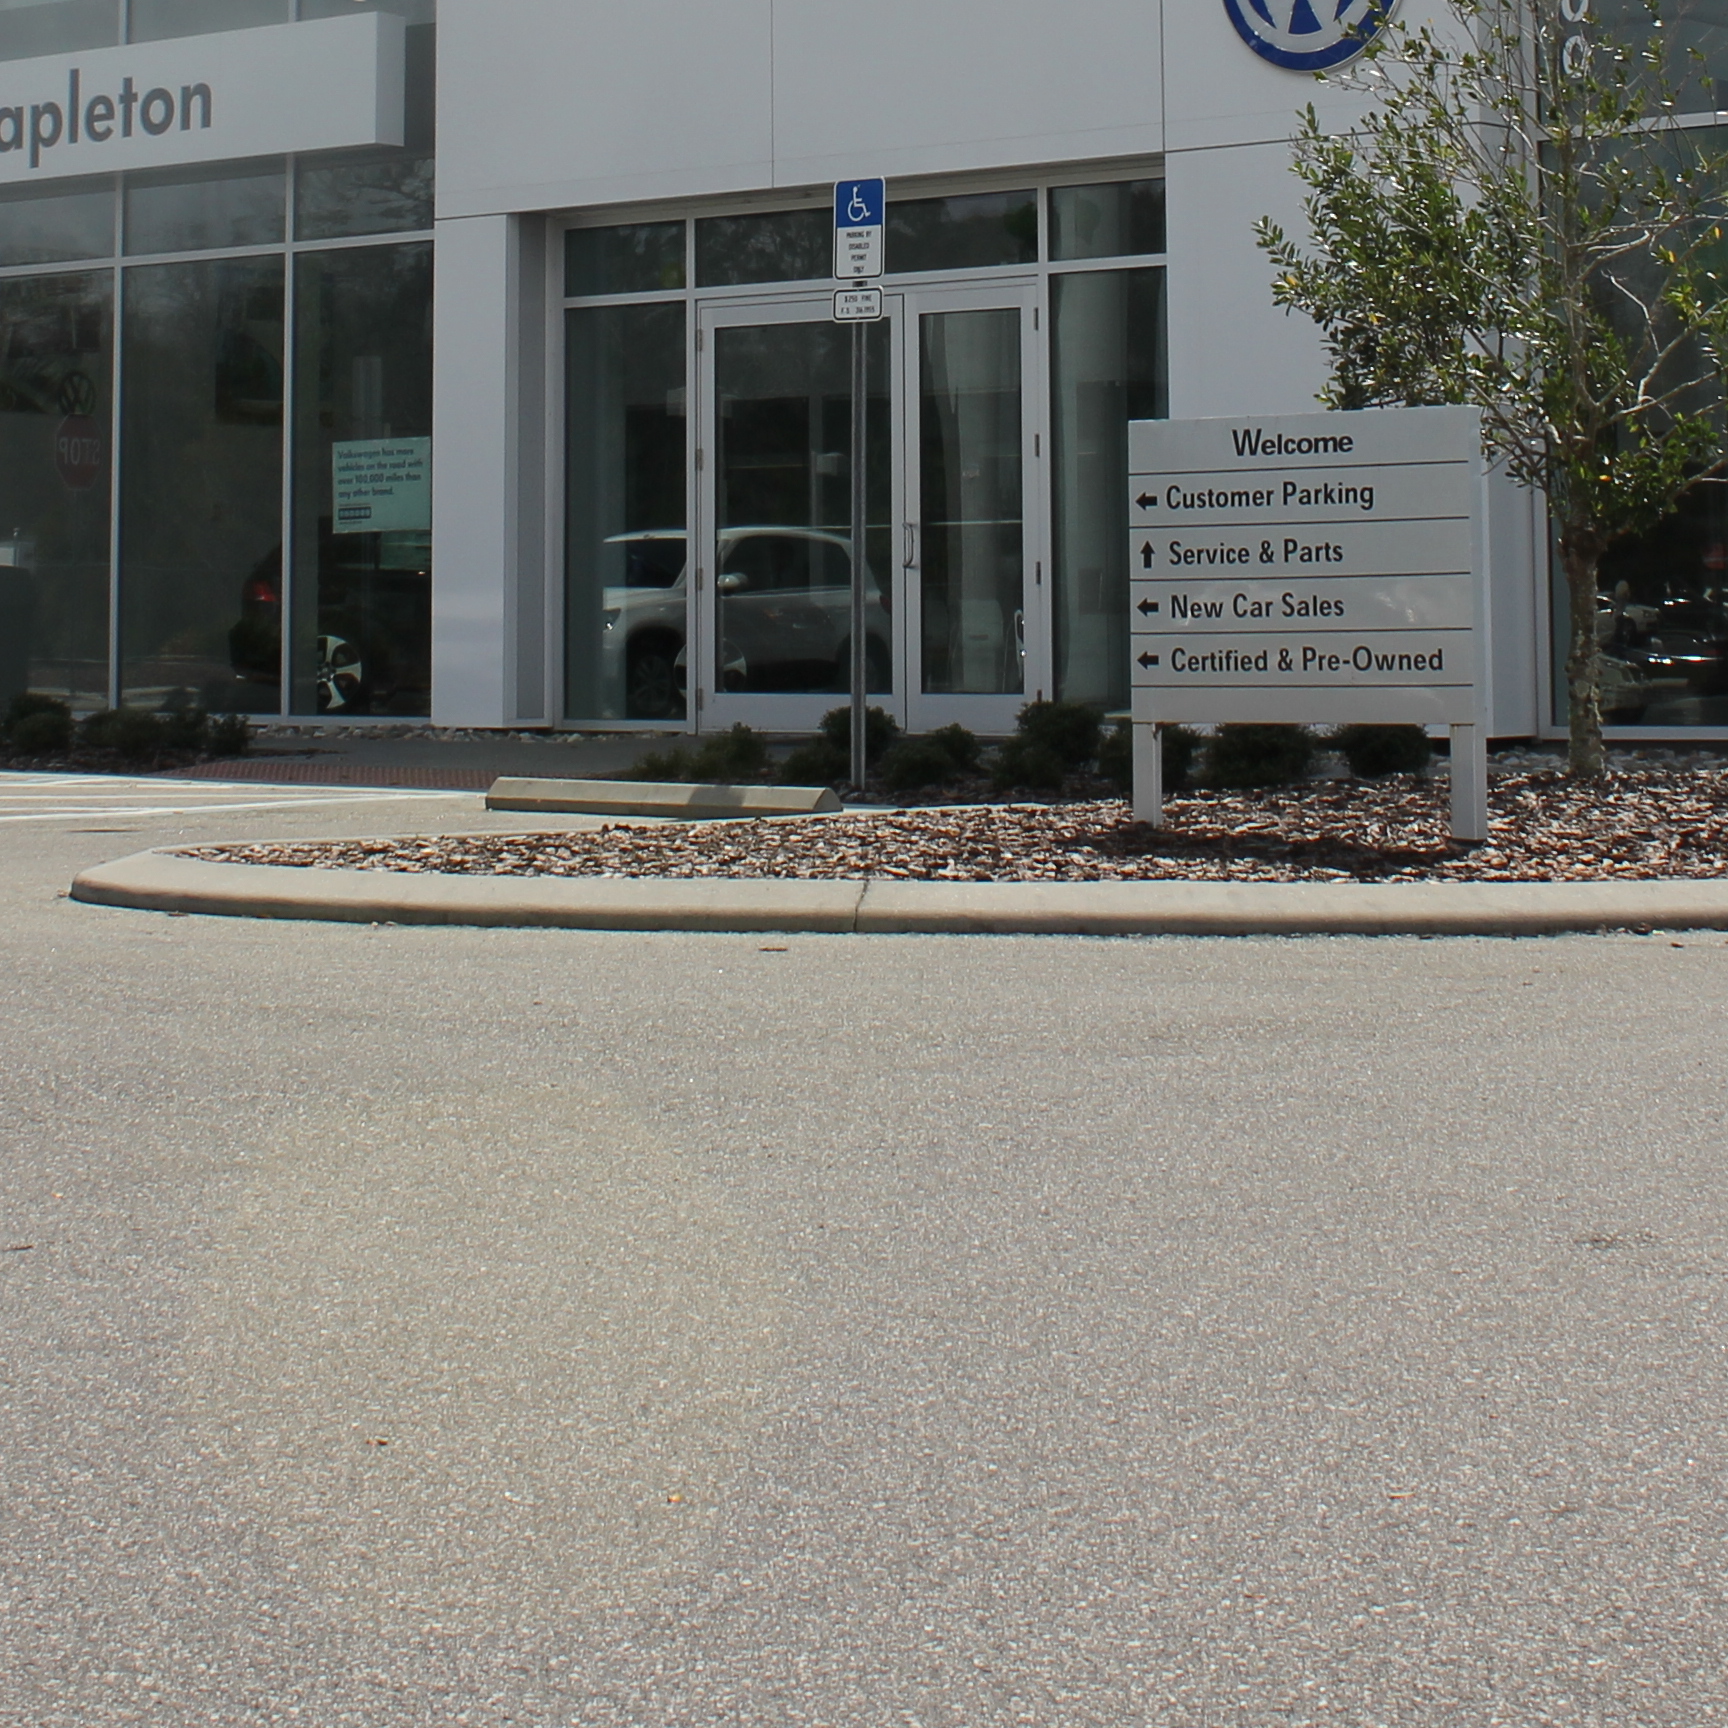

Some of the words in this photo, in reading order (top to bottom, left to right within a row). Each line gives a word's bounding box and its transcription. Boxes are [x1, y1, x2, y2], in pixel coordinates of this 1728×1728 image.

[1232, 428, 1354, 457] Welcome
[1166, 484, 1274, 510] Customer
[1282, 481, 1374, 511] Parking
[1169, 540, 1250, 565] Service
[1258, 540, 1274, 564] &
[1283, 538, 1344, 564] Parts
[1171, 594, 1224, 619] New
[1233, 593, 1274, 618] Car
[1281, 592, 1345, 617] Sales
[1171, 647, 1269, 672] Certified
[1277, 647, 1293, 671] &
[1302, 645, 1444, 671] Pre-Owned
